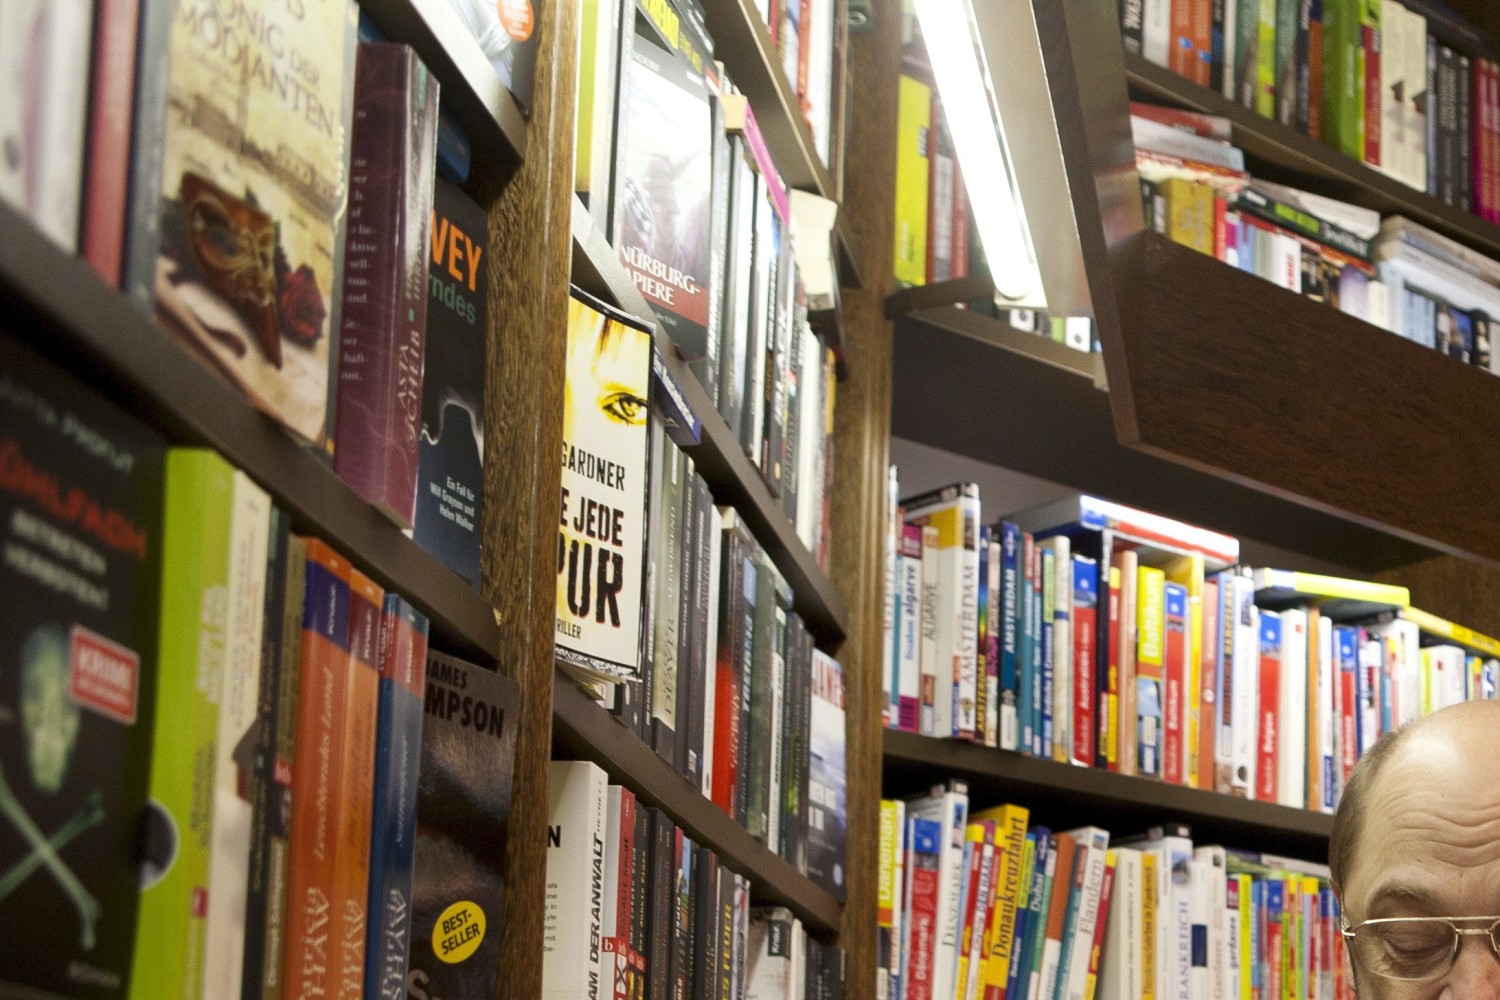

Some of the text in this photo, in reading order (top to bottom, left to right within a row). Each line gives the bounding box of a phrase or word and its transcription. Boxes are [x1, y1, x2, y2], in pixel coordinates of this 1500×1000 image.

[573, 499, 623, 548] JEDE
[902, 566, 918, 616] algarve
[1004, 569, 1016, 654] AMSTERDAM
[1142, 570, 1162, 658] Baltikum
[556, 617, 582, 640] RILLER
[962, 565, 976, 685] AMSTERDAM
[424, 678, 504, 739] MPSON
[592, 833, 603, 922] ANWALT
[879, 807, 894, 900] Dänemark
[992, 817, 1025, 959] Donaukreuzfahrt
[1079, 859, 1102, 934] Flandern
[441, 923, 481, 956] SELLER
[442, 909, 472, 935] BEST-
[589, 923, 600, 964] DER
[1228, 917, 1239, 970] gardasee
